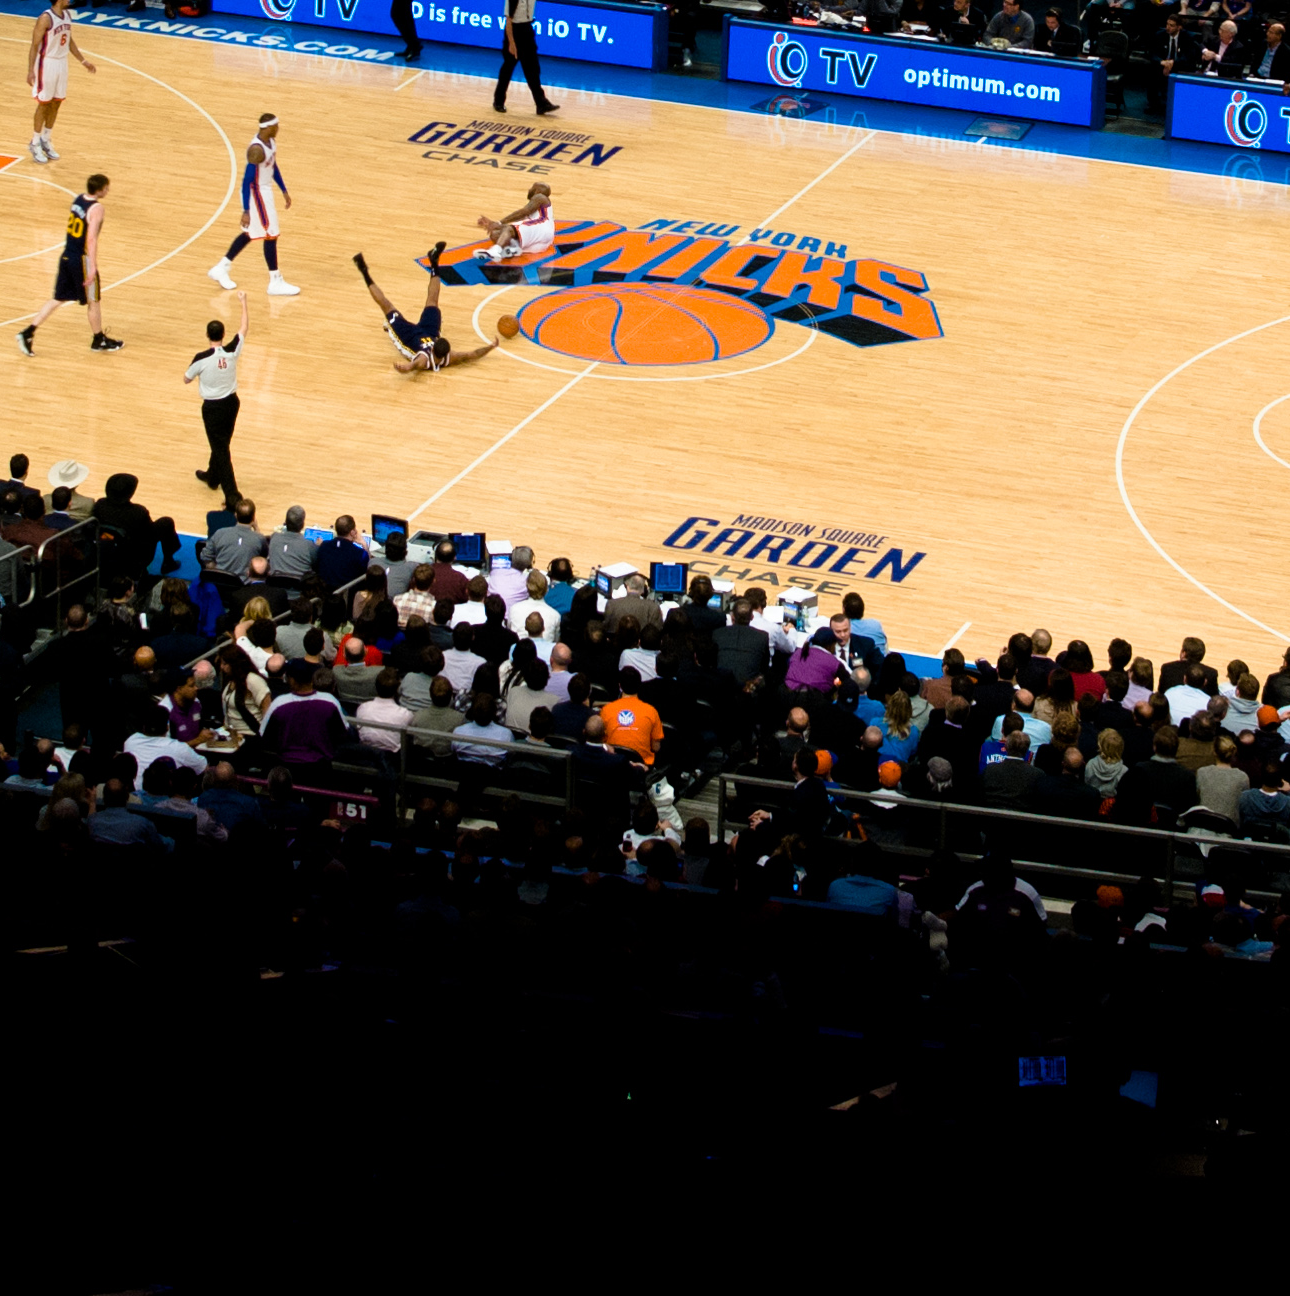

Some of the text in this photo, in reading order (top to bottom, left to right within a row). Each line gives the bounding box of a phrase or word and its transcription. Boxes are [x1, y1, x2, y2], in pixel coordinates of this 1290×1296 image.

[60, 33, 67, 46] 6
[429, 3, 447, 23] is
[451, 6, 492, 28] free
[547, 17, 569, 38] iO
[577, 23, 613, 44] TV.
[820, 47, 877, 88] TV
[903, 67, 1061, 102] optimum.com
[406, 120, 625, 167] GARDEN
[465, 119, 595, 145] MADISON SQUARE
[421, 150, 558, 176] CHASE
[67, 212, 85, 238] 20
[637, 218, 849, 260] NEW YORK
[413, 219, 946, 348] KNICKS
[661, 516, 928, 584] GARDEN
[731, 513, 890, 549] MADISON SQUARE
[686, 560, 850, 597] CHASE
